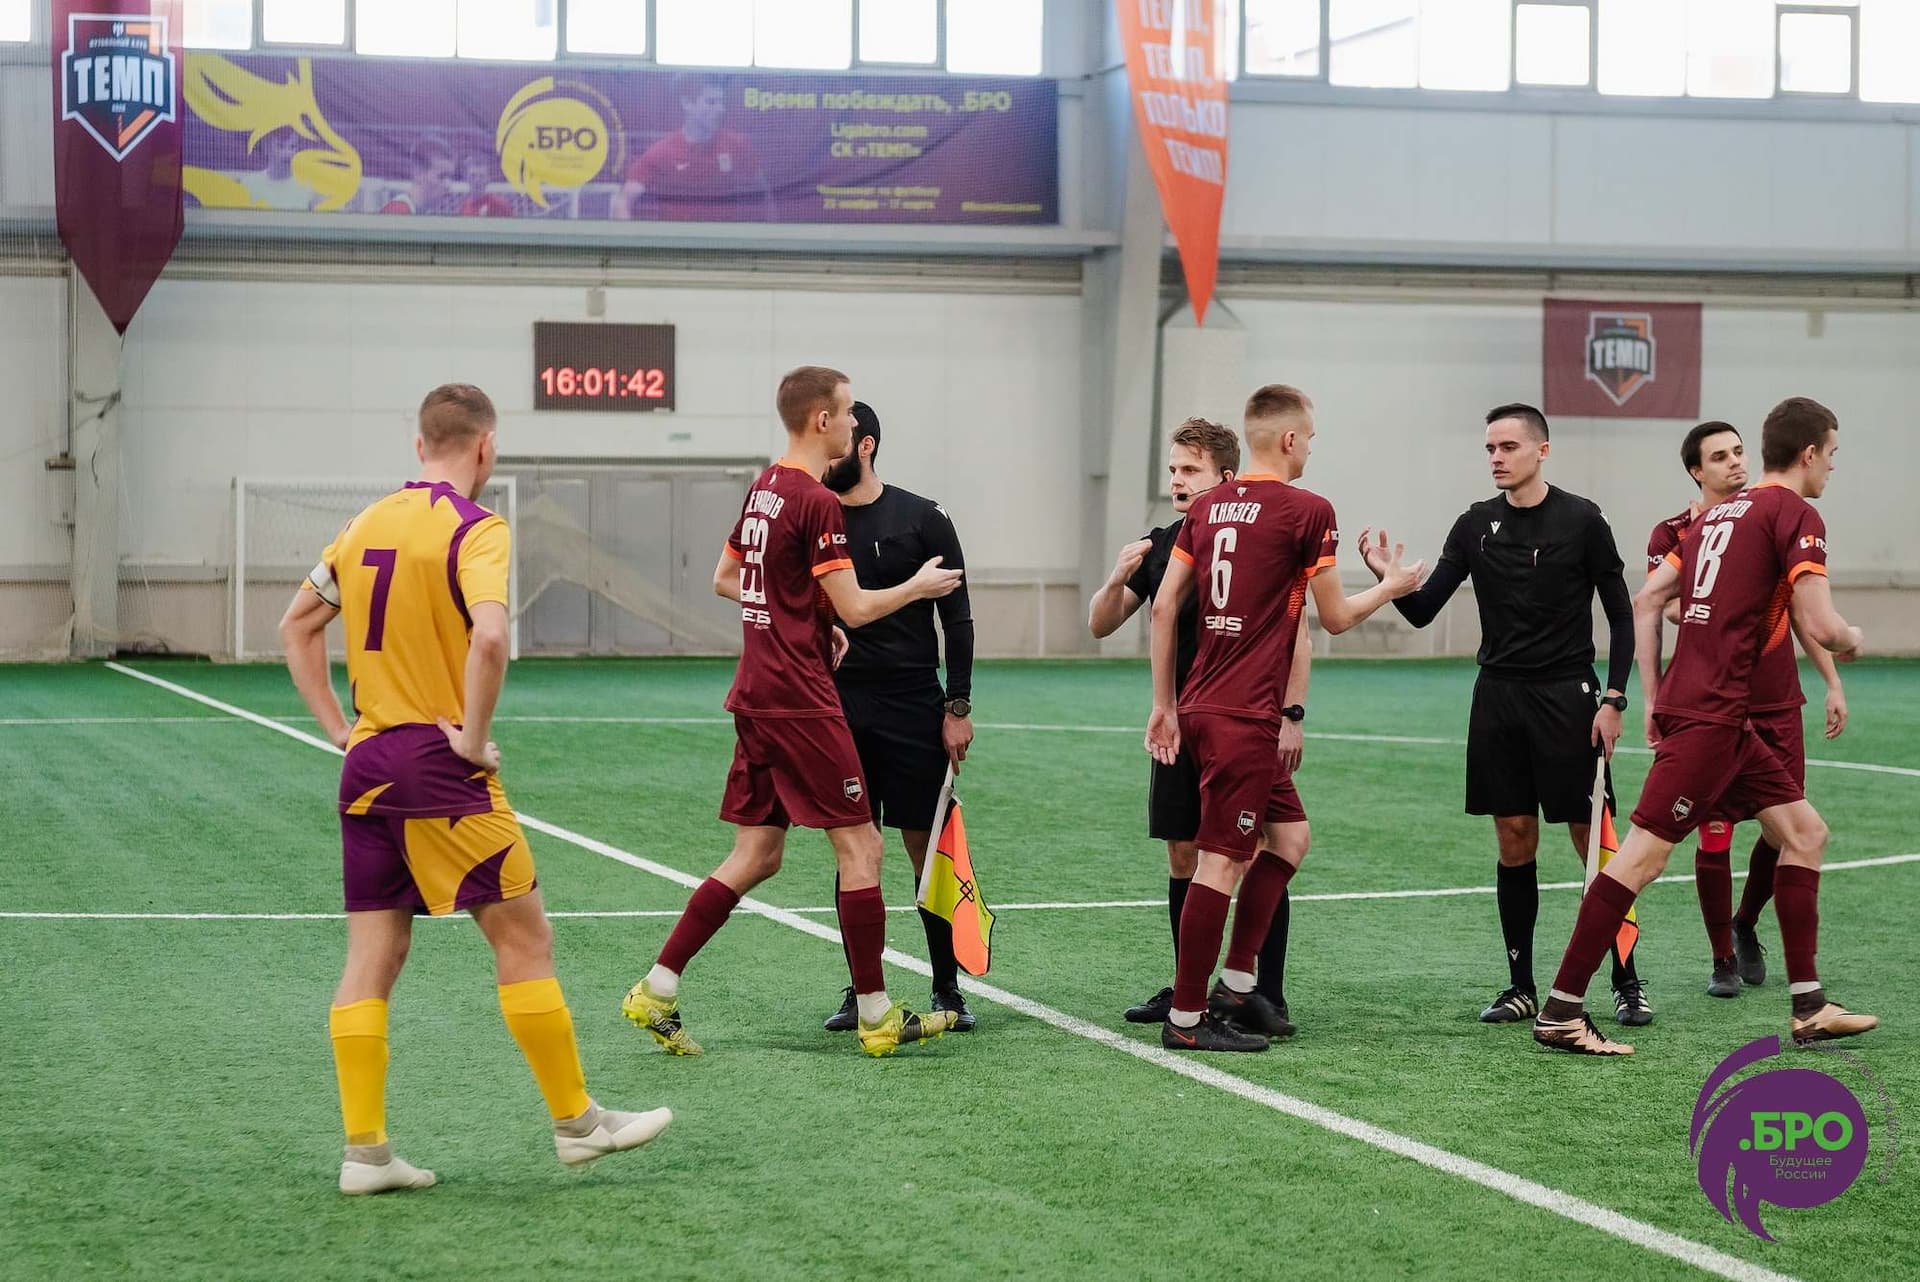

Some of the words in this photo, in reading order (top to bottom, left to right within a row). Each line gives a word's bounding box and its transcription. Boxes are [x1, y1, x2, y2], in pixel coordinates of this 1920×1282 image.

[74, 55, 164, 107] ТЕМП
[1140, 42, 1213, 88] ТЕП,
[744, 87, 818, 112] Время
[1140, 90, 1227, 139] ТОЛЬКО
[528, 126, 598, 150] .БРО
[831, 142, 852, 158] СК
[1592, 338, 1648, 372] ТЕМП
[541, 366, 665, 398] 16:01:42
[1208, 502, 1262, 525] КНЯЗЕВ
[739, 518, 769, 605] 33
[1211, 527, 1238, 610] 6
[1692, 520, 1734, 599] 18
[361, 548, 397, 651] 7
